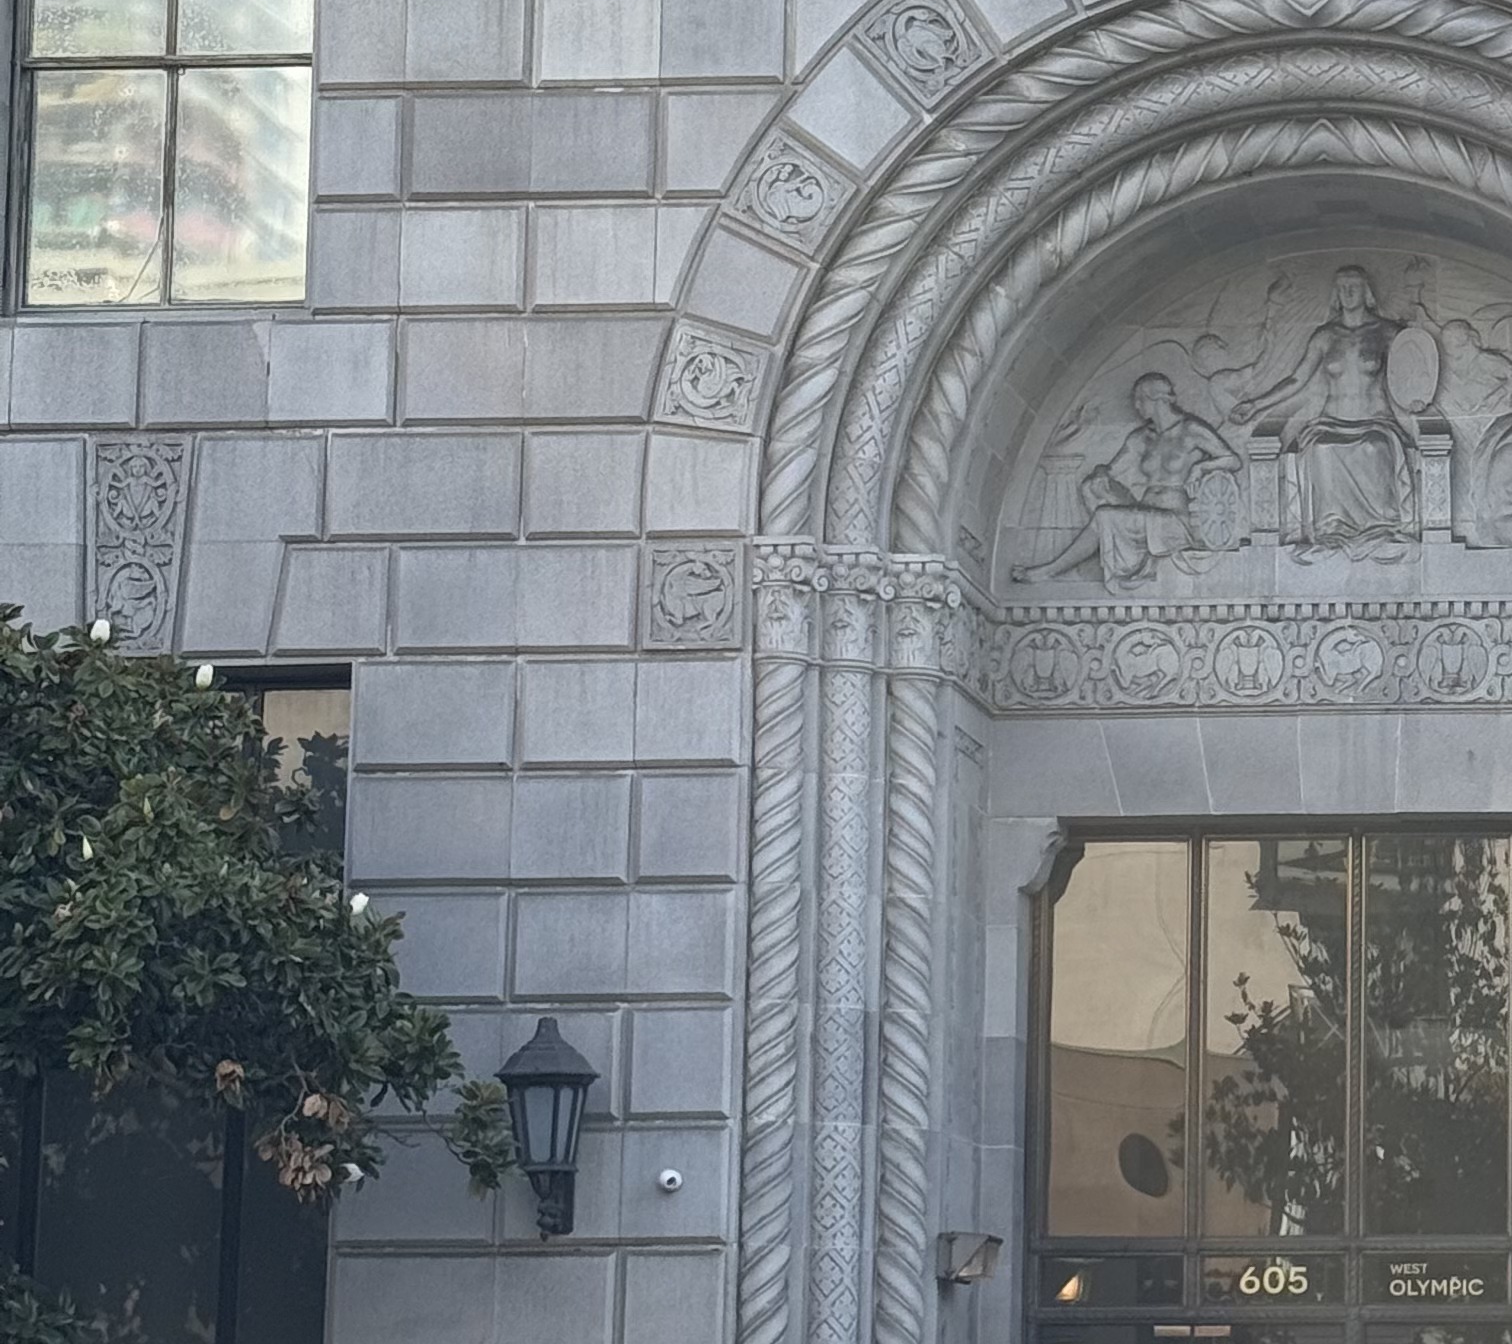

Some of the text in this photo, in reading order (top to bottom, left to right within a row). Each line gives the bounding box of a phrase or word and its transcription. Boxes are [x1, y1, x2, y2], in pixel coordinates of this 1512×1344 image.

[1390, 1263, 1428, 1275] WEST
[1239, 1266, 1309, 1295] 605
[1389, 1278, 1485, 1297] OLYMPIC
